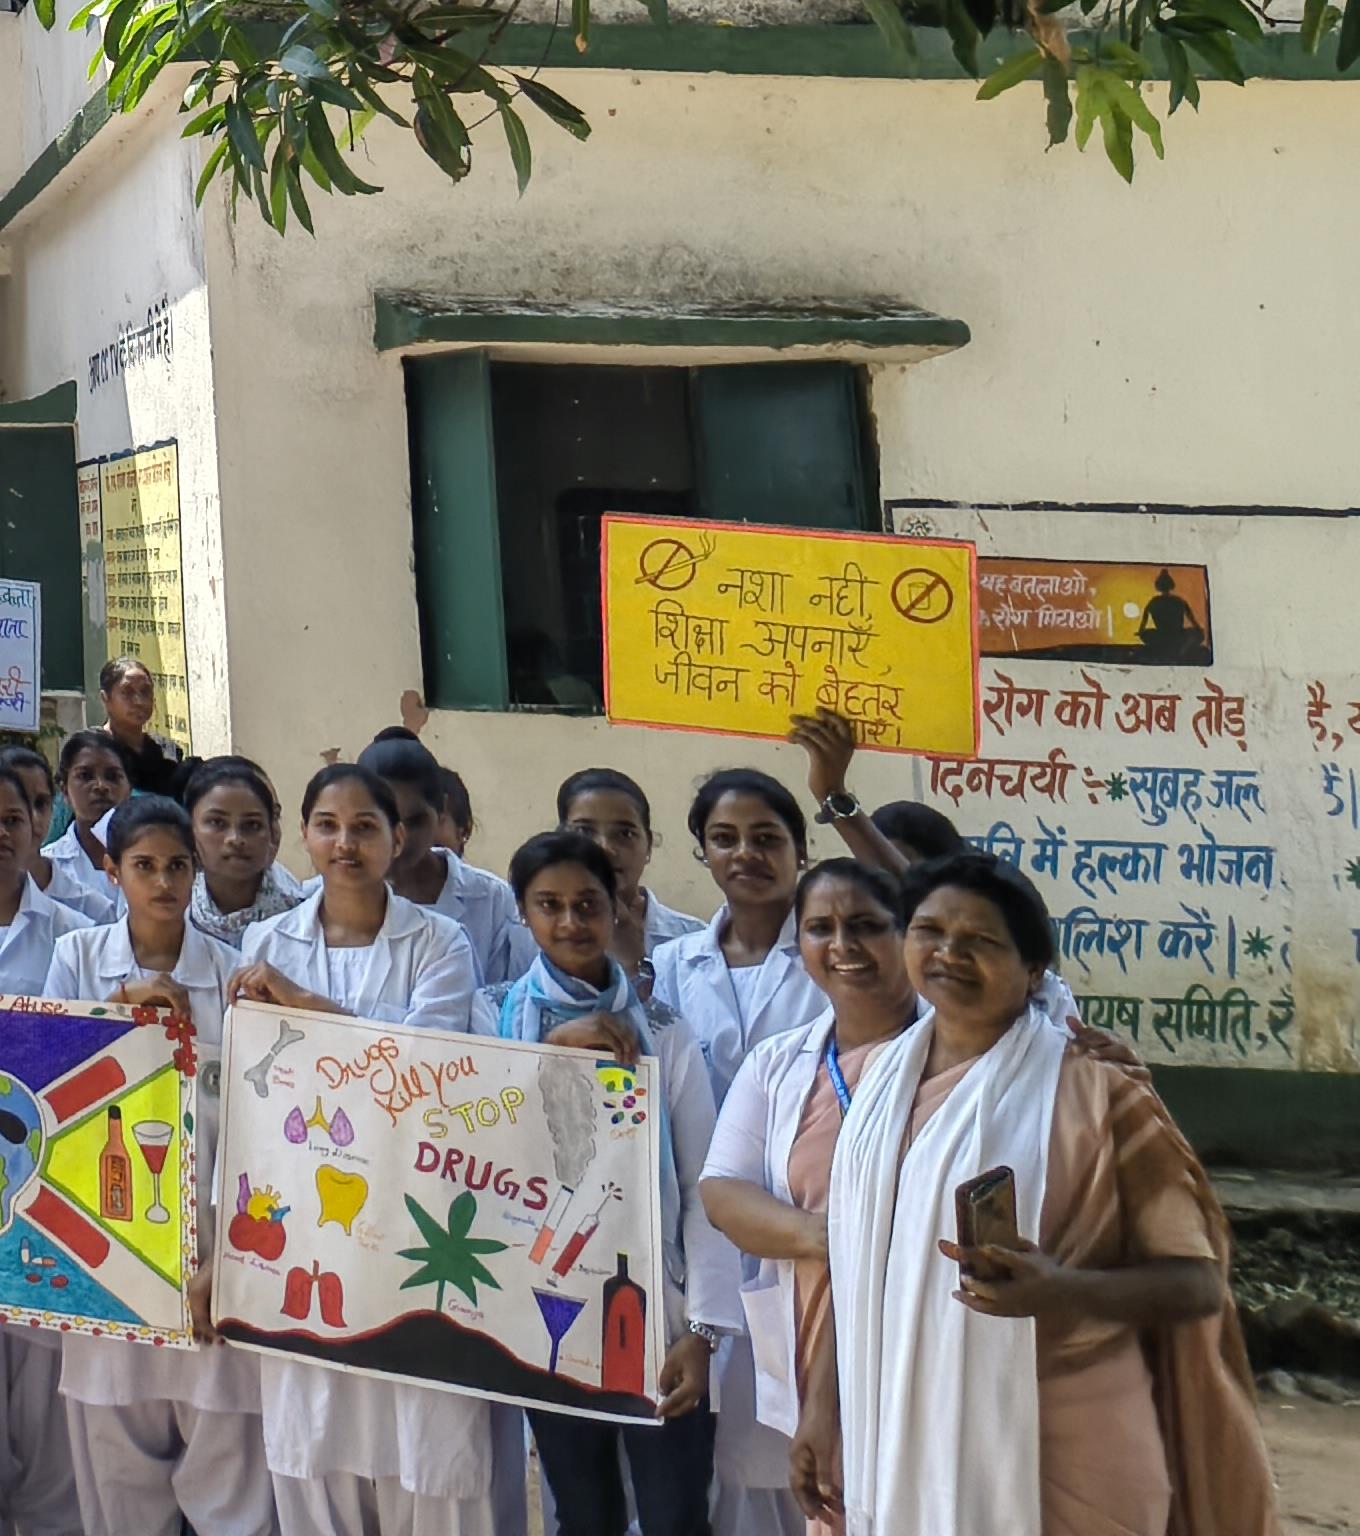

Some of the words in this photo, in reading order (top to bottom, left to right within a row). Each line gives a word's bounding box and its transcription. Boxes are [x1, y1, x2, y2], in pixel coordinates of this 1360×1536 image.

[718, 567, 794, 614] नशा
[648, 598, 729, 655] शिक्षा
[655, 650, 751, 702] जीवन
[758, 660, 805, 707] को
[981, 669, 1050, 735] रोग
[1054, 668, 1110, 731] को
[1114, 684, 1181, 734] अब
[1126, 766, 1206, 826] सुबह
[1030, 816, 1069, 880] में
[1073, 835, 1169, 898] हल्का
[1177, 823, 1279, 891] भोजन
[423, 1086, 525, 1139] STOP
[414, 1141, 548, 1211] DRUGS
